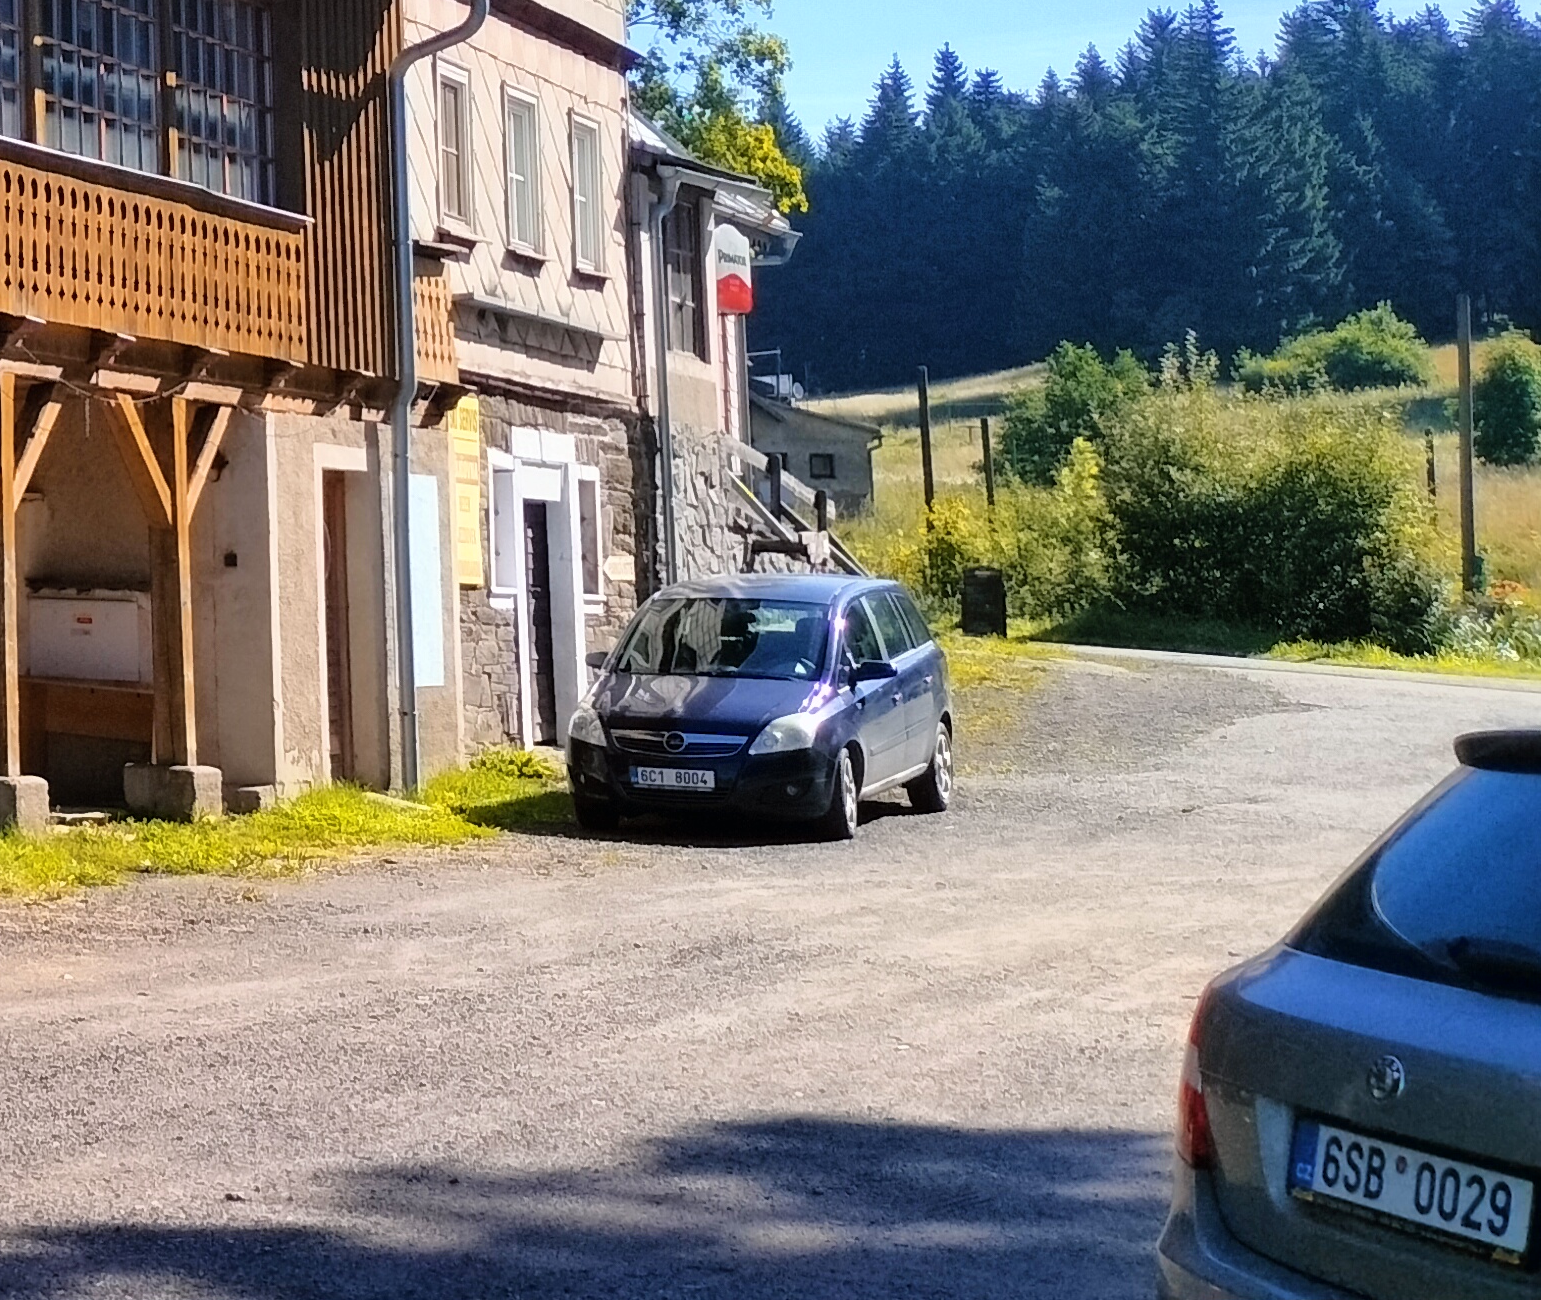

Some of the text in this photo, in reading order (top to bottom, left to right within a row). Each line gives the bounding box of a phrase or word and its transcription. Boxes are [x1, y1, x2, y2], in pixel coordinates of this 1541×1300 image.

[640, 769, 665, 783] 6C1
[1322, 1135, 1513, 1237] 6SB 0029
